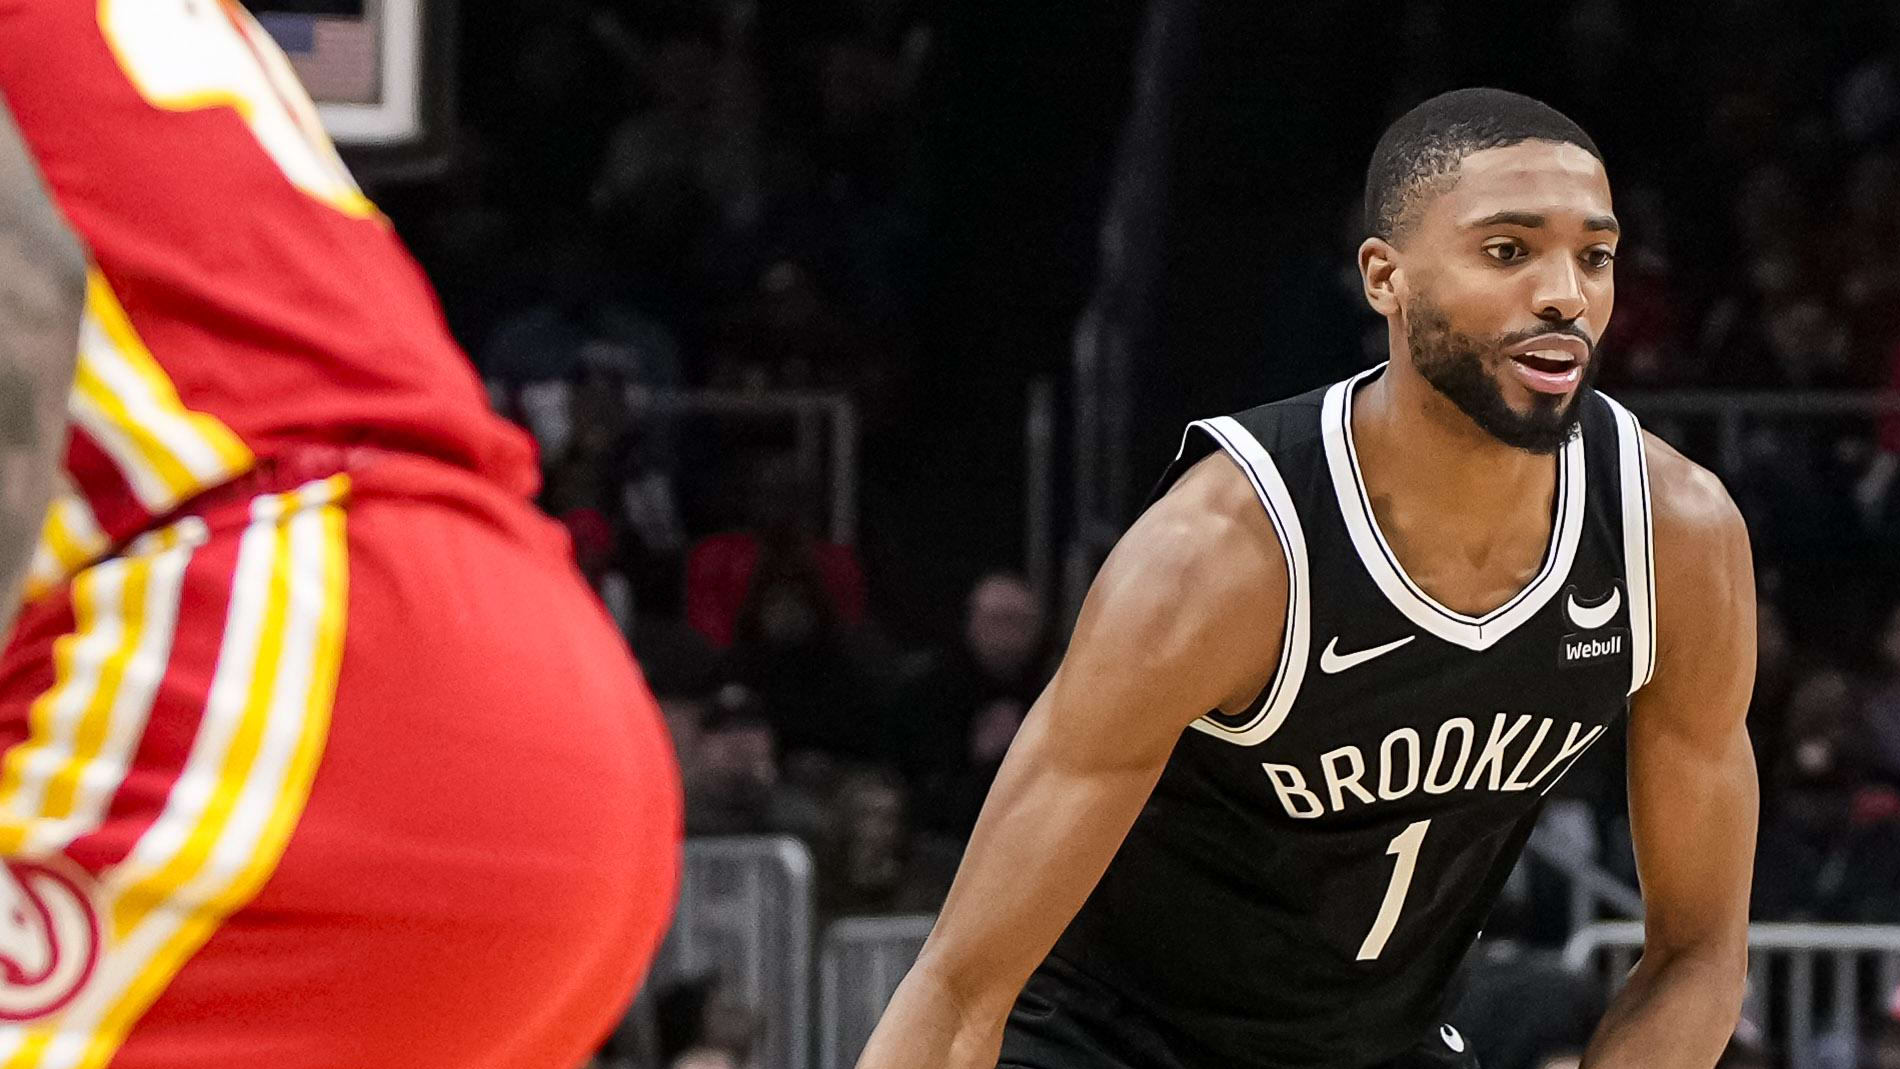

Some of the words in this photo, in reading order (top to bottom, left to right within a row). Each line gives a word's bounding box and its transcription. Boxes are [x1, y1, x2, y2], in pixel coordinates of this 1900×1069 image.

[1566, 635, 1622, 660] Webull
[1262, 712, 1608, 819] BROOKLY
[1356, 818, 1432, 961] 1
